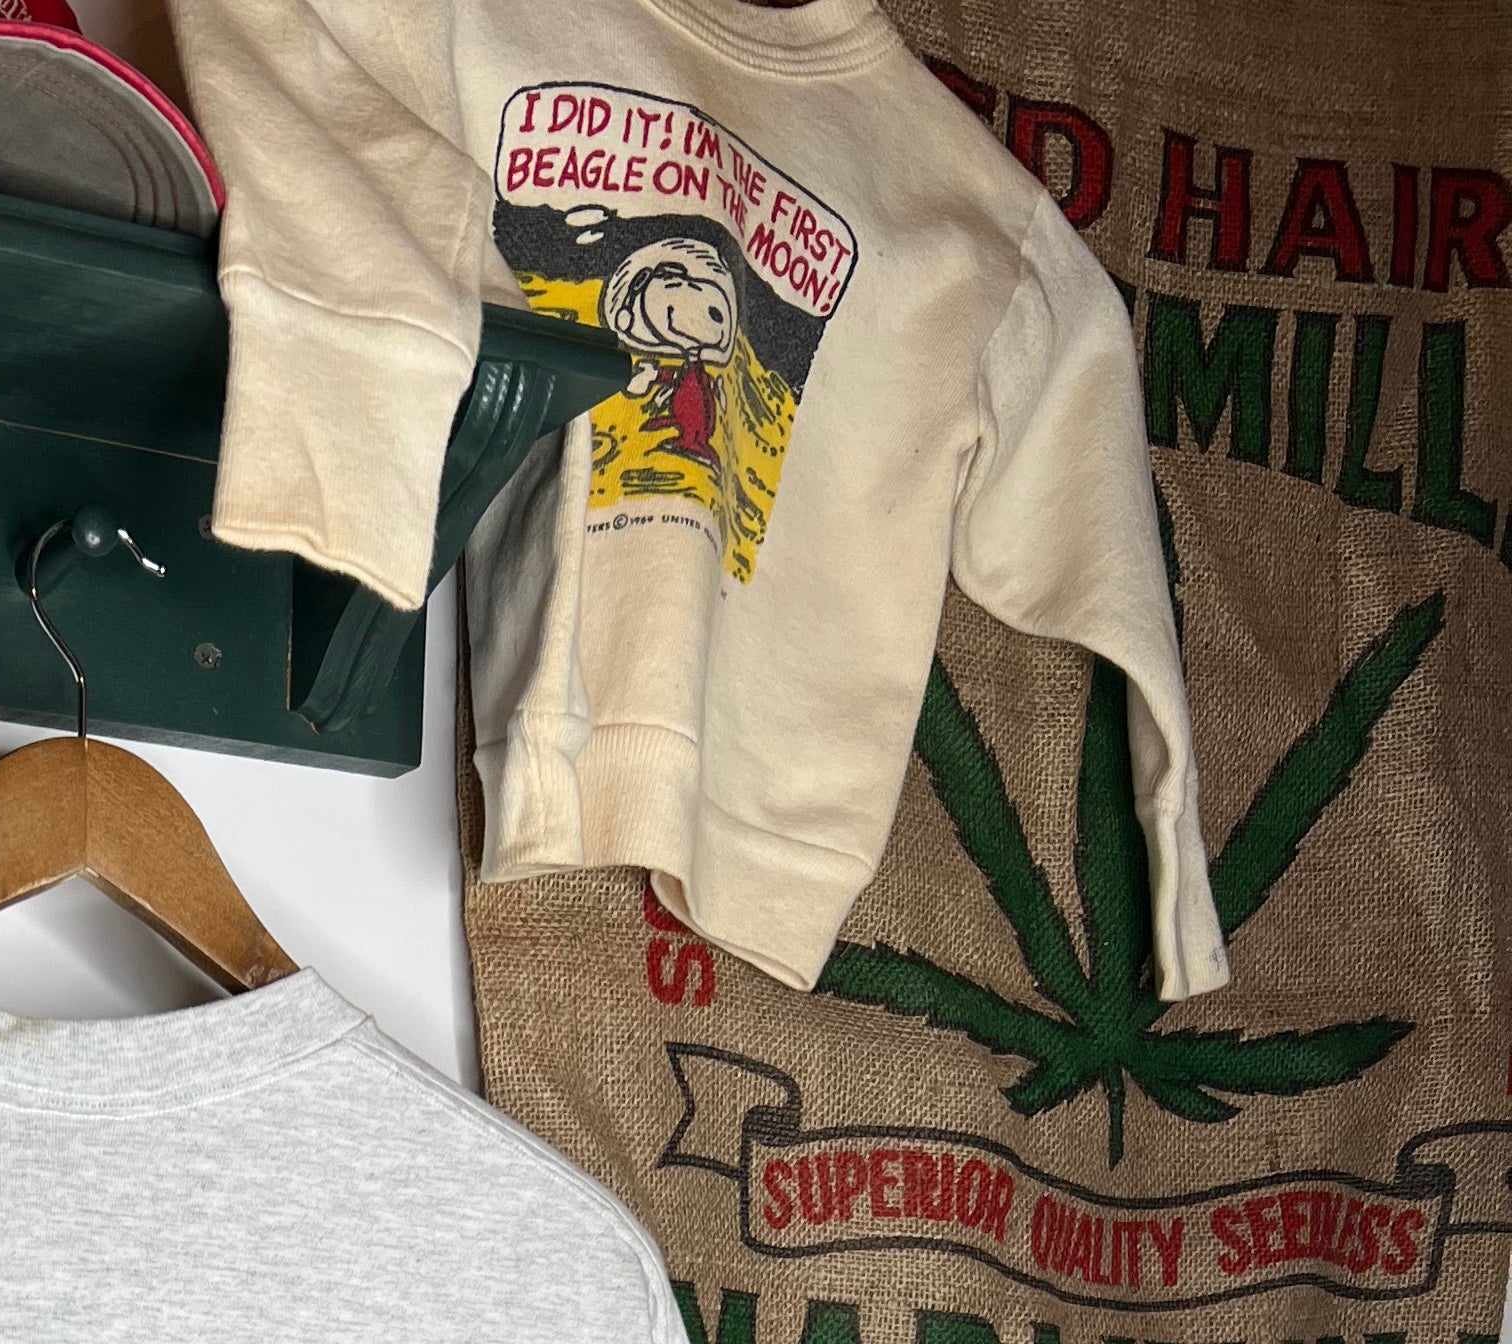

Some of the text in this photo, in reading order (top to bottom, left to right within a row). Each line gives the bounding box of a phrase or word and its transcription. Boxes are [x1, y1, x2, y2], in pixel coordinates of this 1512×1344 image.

[507, 147, 840, 312] BEAGLE ON THE MOON!
[520, 93, 850, 275] I DID IT! I'M THE FIRST
[662, 515, 700, 529] UNITED
[762, 1148, 1014, 1243] SUPERIOR
[1031, 1195, 1184, 1288] QUALITY
